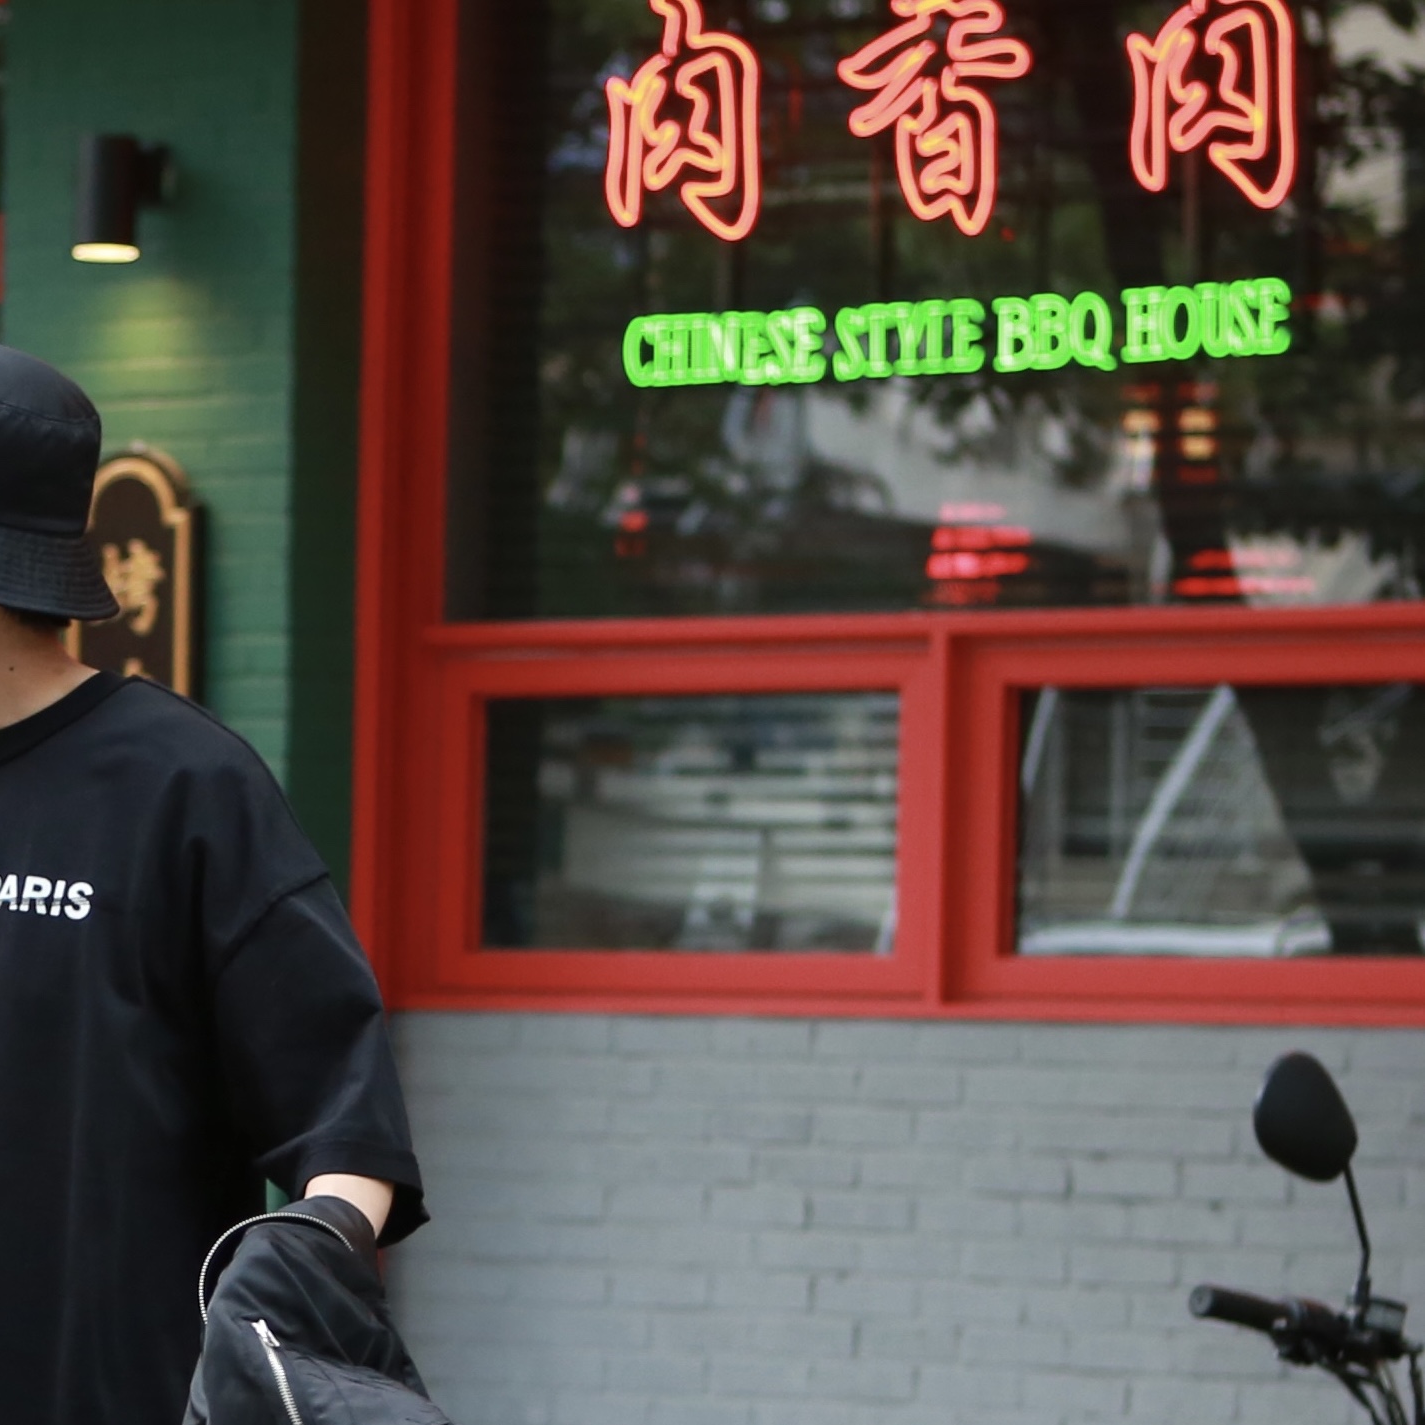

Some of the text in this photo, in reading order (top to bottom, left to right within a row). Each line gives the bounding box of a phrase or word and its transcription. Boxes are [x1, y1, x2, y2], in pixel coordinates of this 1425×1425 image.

[622, 277, 1292, 388] CHINESE STYLE BBQ HOUSE
